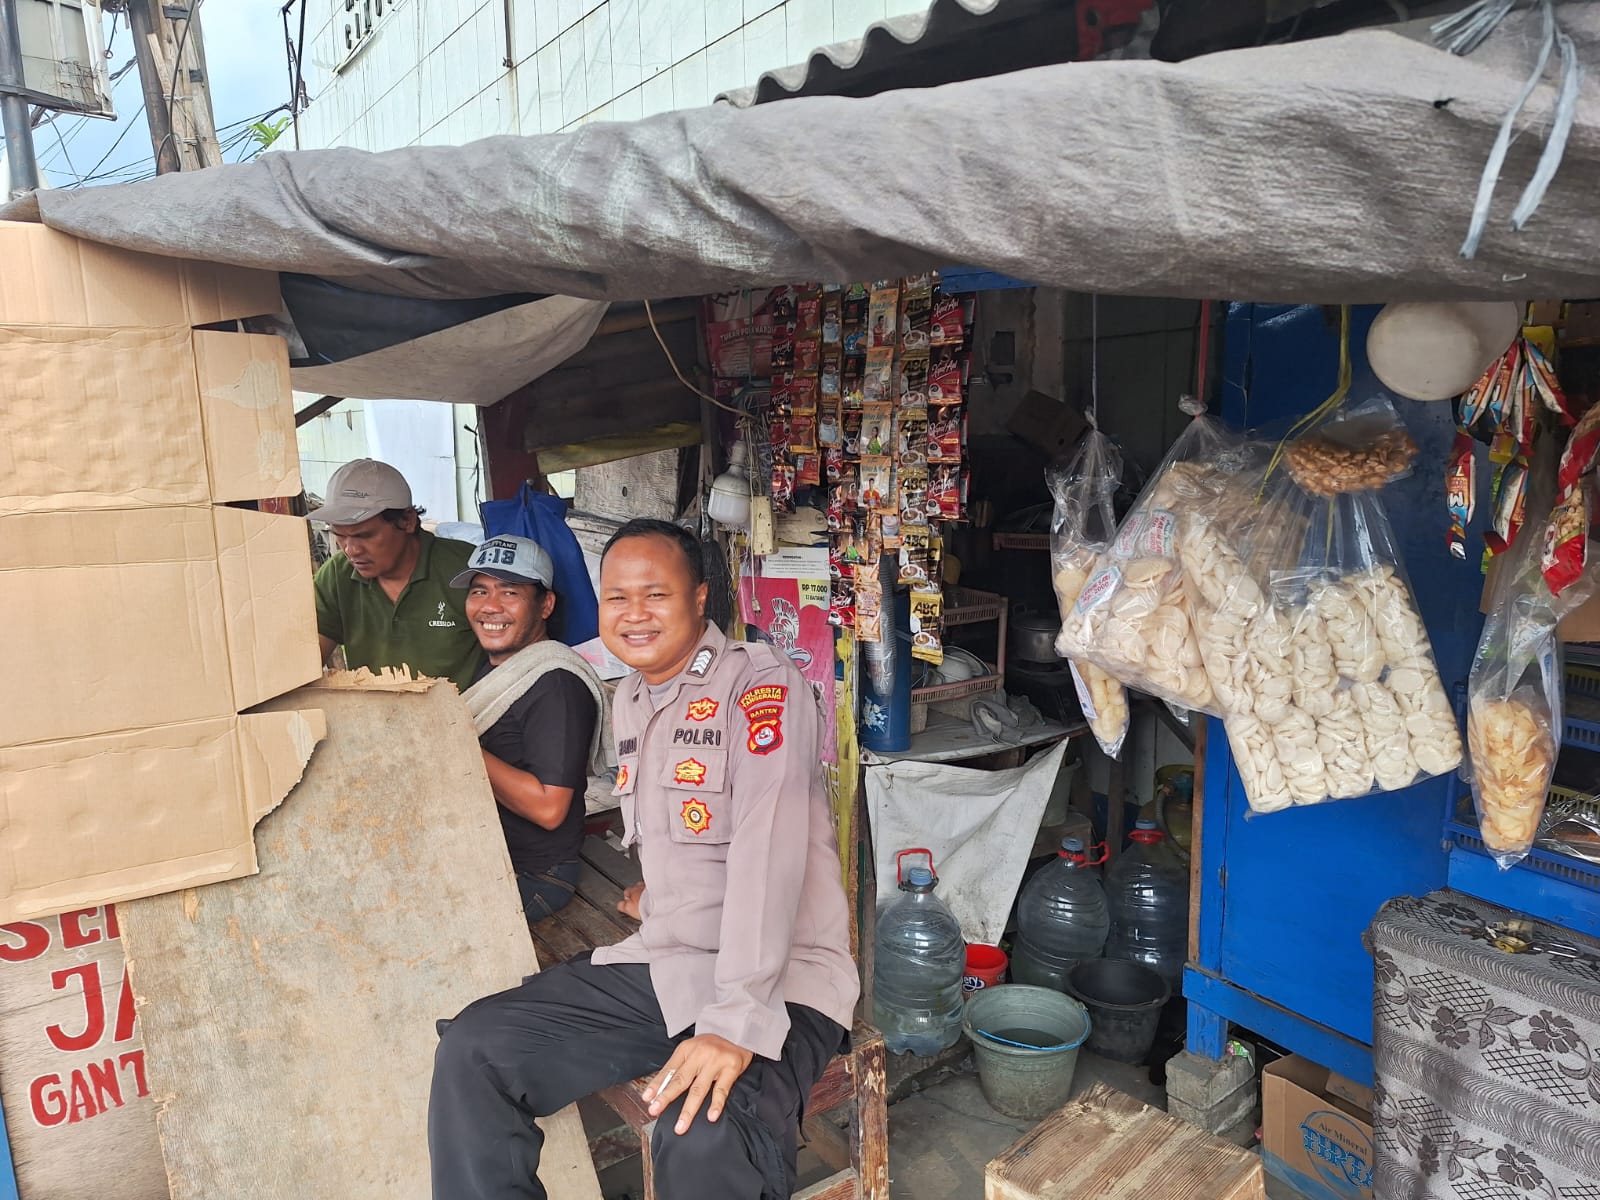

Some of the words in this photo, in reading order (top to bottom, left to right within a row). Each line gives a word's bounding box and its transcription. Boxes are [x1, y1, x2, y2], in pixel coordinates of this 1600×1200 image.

[901, 419, 927, 433] ABC
[902, 477, 927, 491] ABC
[901, 534, 928, 548] ABC
[912, 601, 938, 616] ABC
[740, 687, 782, 706] POLRESTA
[750, 708, 779, 719] BANTEN
[673, 728, 722, 746] POLRI
[1319, 1122, 1332, 1134] Air
[1334, 1129, 1368, 1157] Mineral
